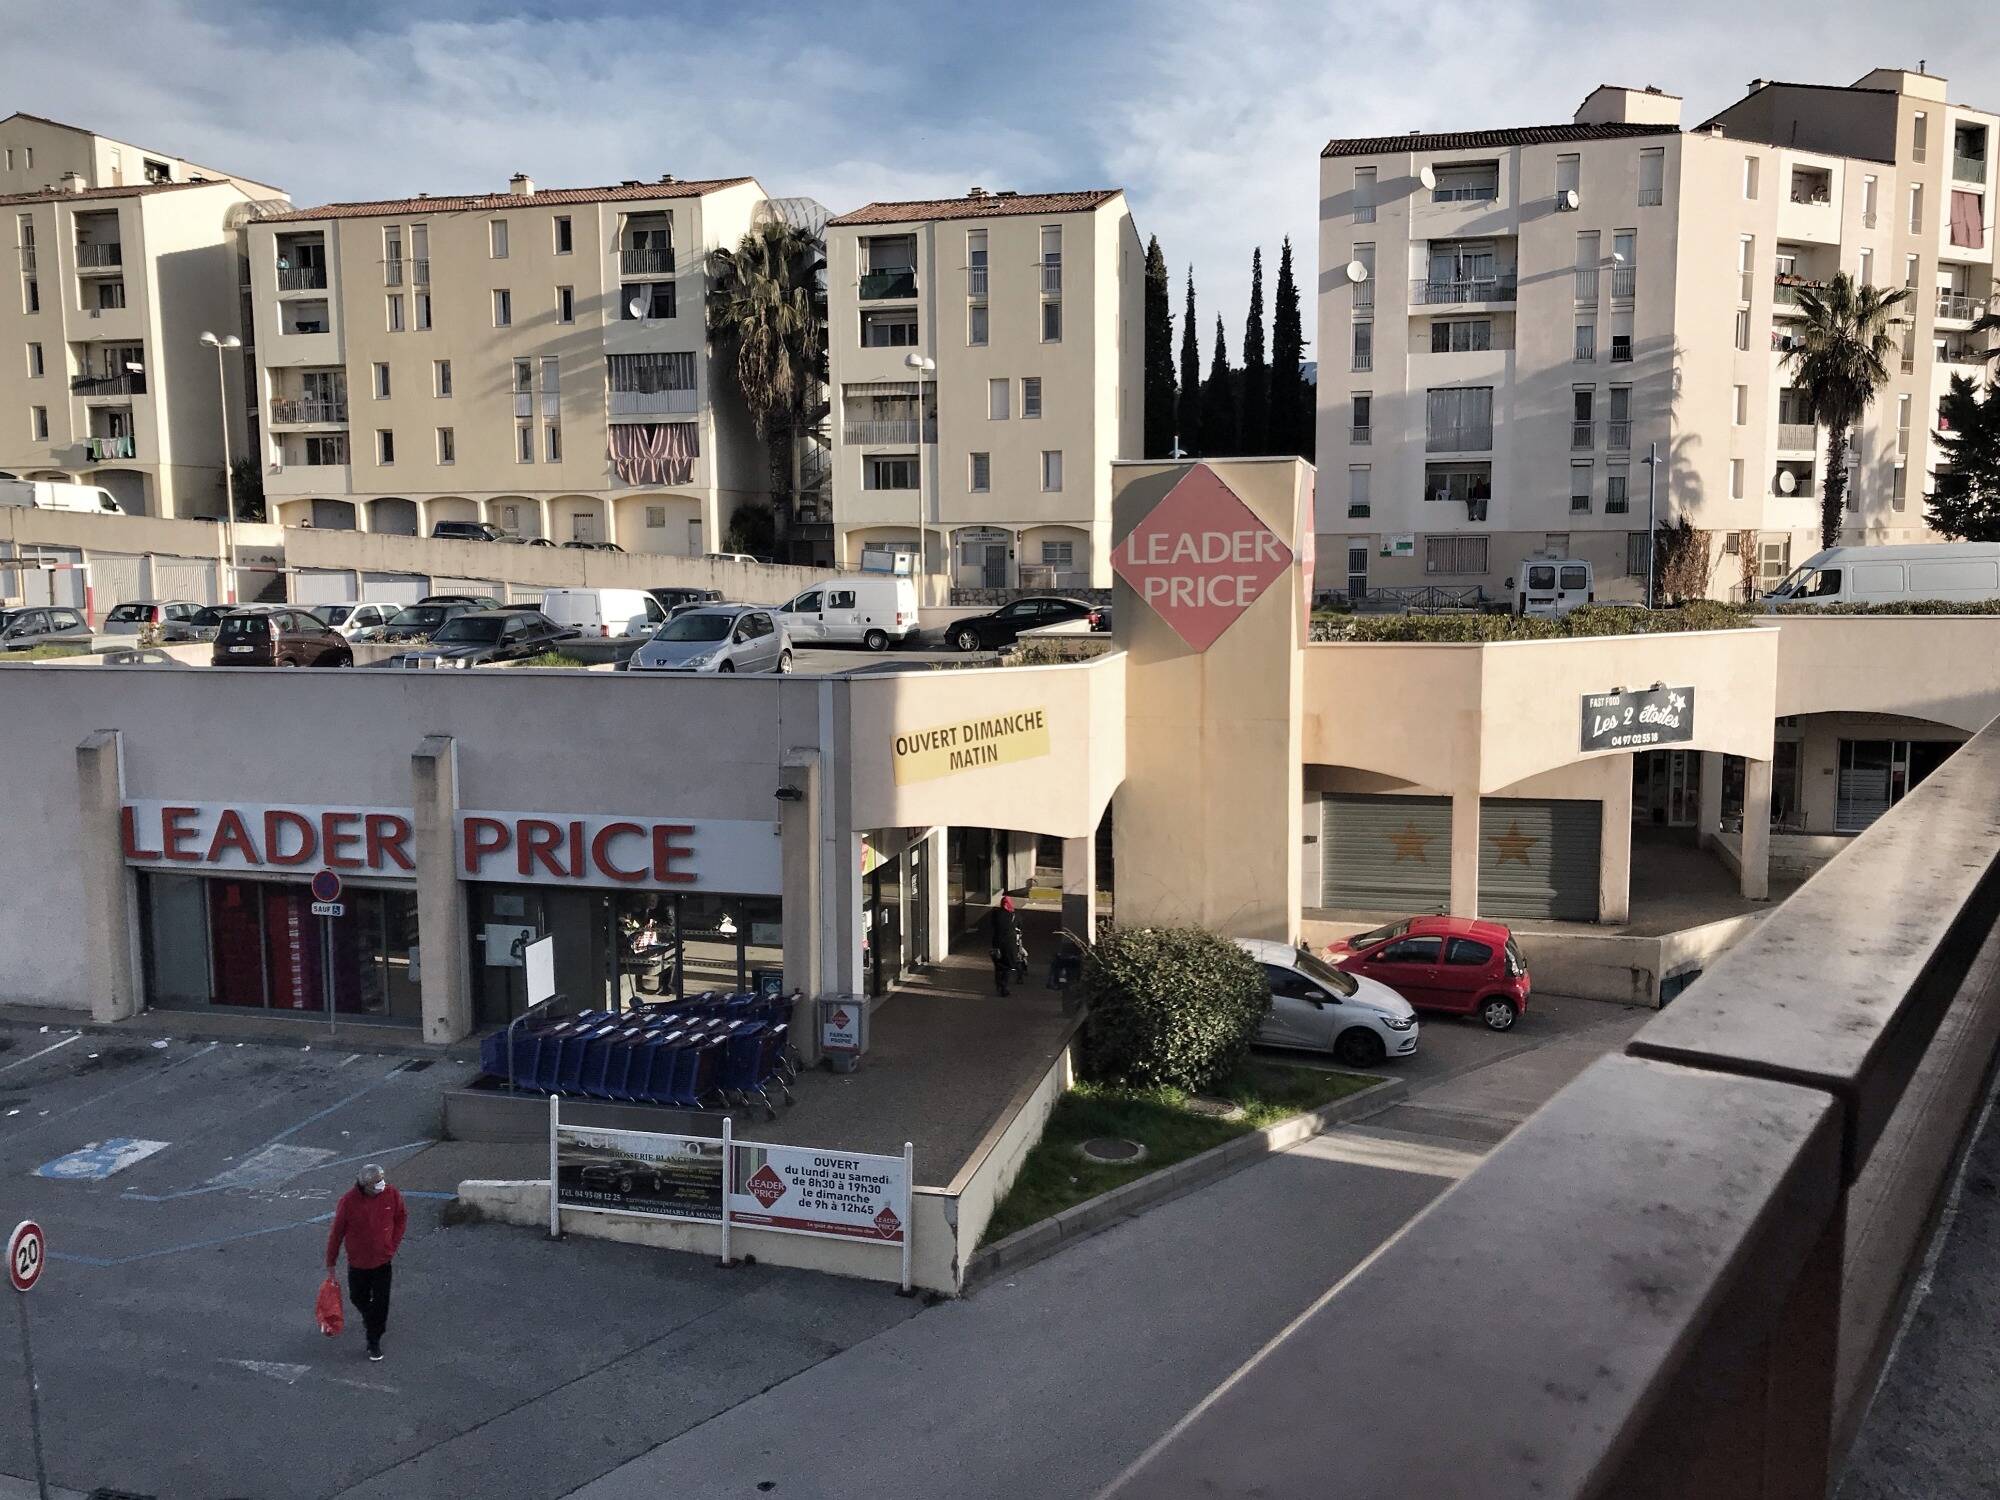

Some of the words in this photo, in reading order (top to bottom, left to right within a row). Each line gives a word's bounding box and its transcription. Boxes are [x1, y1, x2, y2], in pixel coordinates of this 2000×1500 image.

[1127, 530, 1281, 565] LEADER
[1144, 575, 1257, 608] PRICE
[1590, 698, 1604, 708] FAST
[1606, 696, 1620, 706] FOOD
[1593, 715, 1619, 738] Les
[1623, 707, 1634, 725] 2
[1639, 704, 1680, 728] étoiles
[896, 727, 957, 756] OUVERT
[963, 710, 1044, 743] DIMANCHE
[1611, 736, 1621, 746] 04
[1622, 735, 1631, 745] 97
[1632, 734, 1642, 744] 02
[949, 744, 999, 770] MATIN
[121, 805, 416, 871] LEADER
[463, 817, 699, 883] PRICE
[313, 905, 331, 913] SAUF
[814, 1157, 860, 1171] OUVERT
[785, 1165, 799, 1175] du
[801, 1166, 829, 1178] lundi
[832, 1171, 846, 1180] au
[848, 1173, 889, 1185] samedi
[749, 1180, 785, 1191] LEADER
[754, 1188, 780, 1199] PRICE
[792, 1176, 805, 1186] de
[808, 1179, 835, 1190] 8h30
[838, 1181, 845, 1191] à
[847, 1182, 881, 1194] 19h30
[574, 1190, 583, 1198] 04
[584, 1191, 593, 1199] 93
[802, 1188, 813, 1197] le
[816, 1189, 871, 1204] dimanche
[798, 1198, 812, 1208] de
[815, 1200, 828, 1210] 9h
[831, 1201, 837, 1211] à
[841, 1202, 874, 1215] 12h45
[19, 1239, 37, 1275] 20
